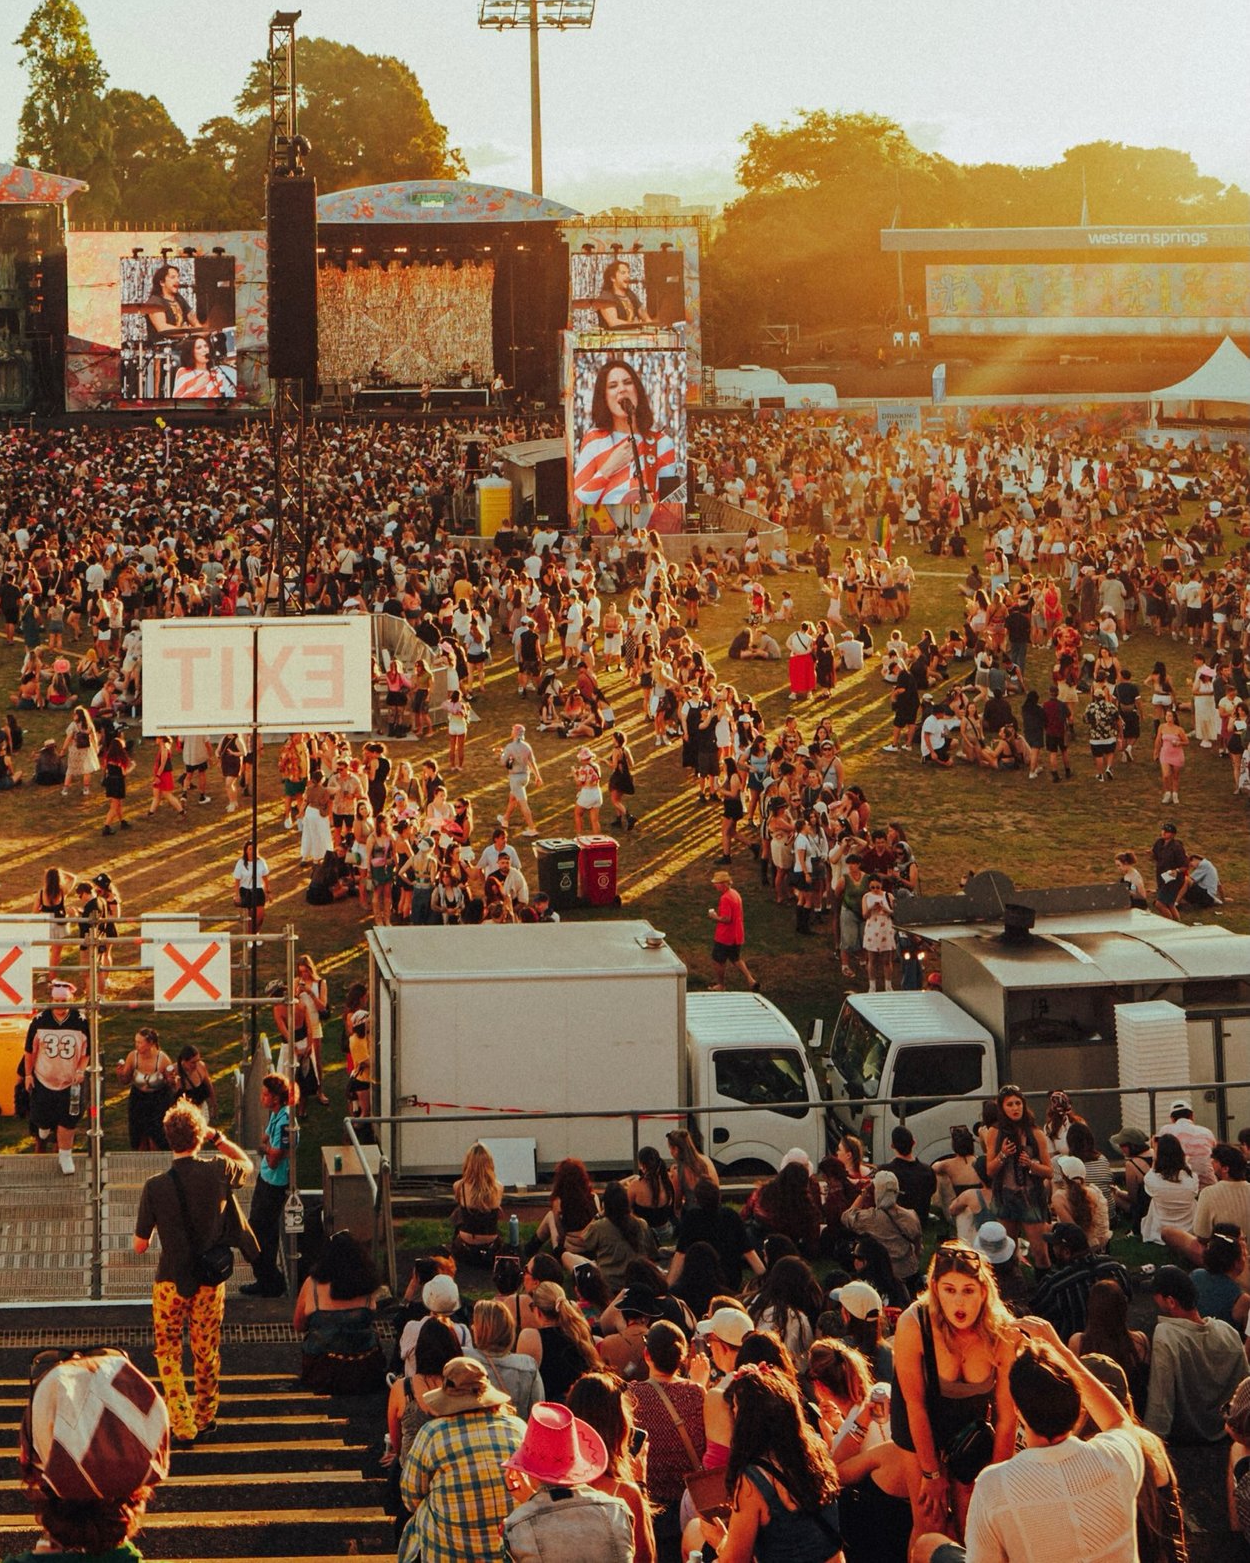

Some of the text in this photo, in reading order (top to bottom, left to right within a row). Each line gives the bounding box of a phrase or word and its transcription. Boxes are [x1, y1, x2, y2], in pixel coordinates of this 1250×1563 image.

[1088, 231, 1150, 245] western
[1153, 229, 1208, 247] springs
[881, 412, 917, 420] DRINKING
[43, 1033, 77, 1060] 33
